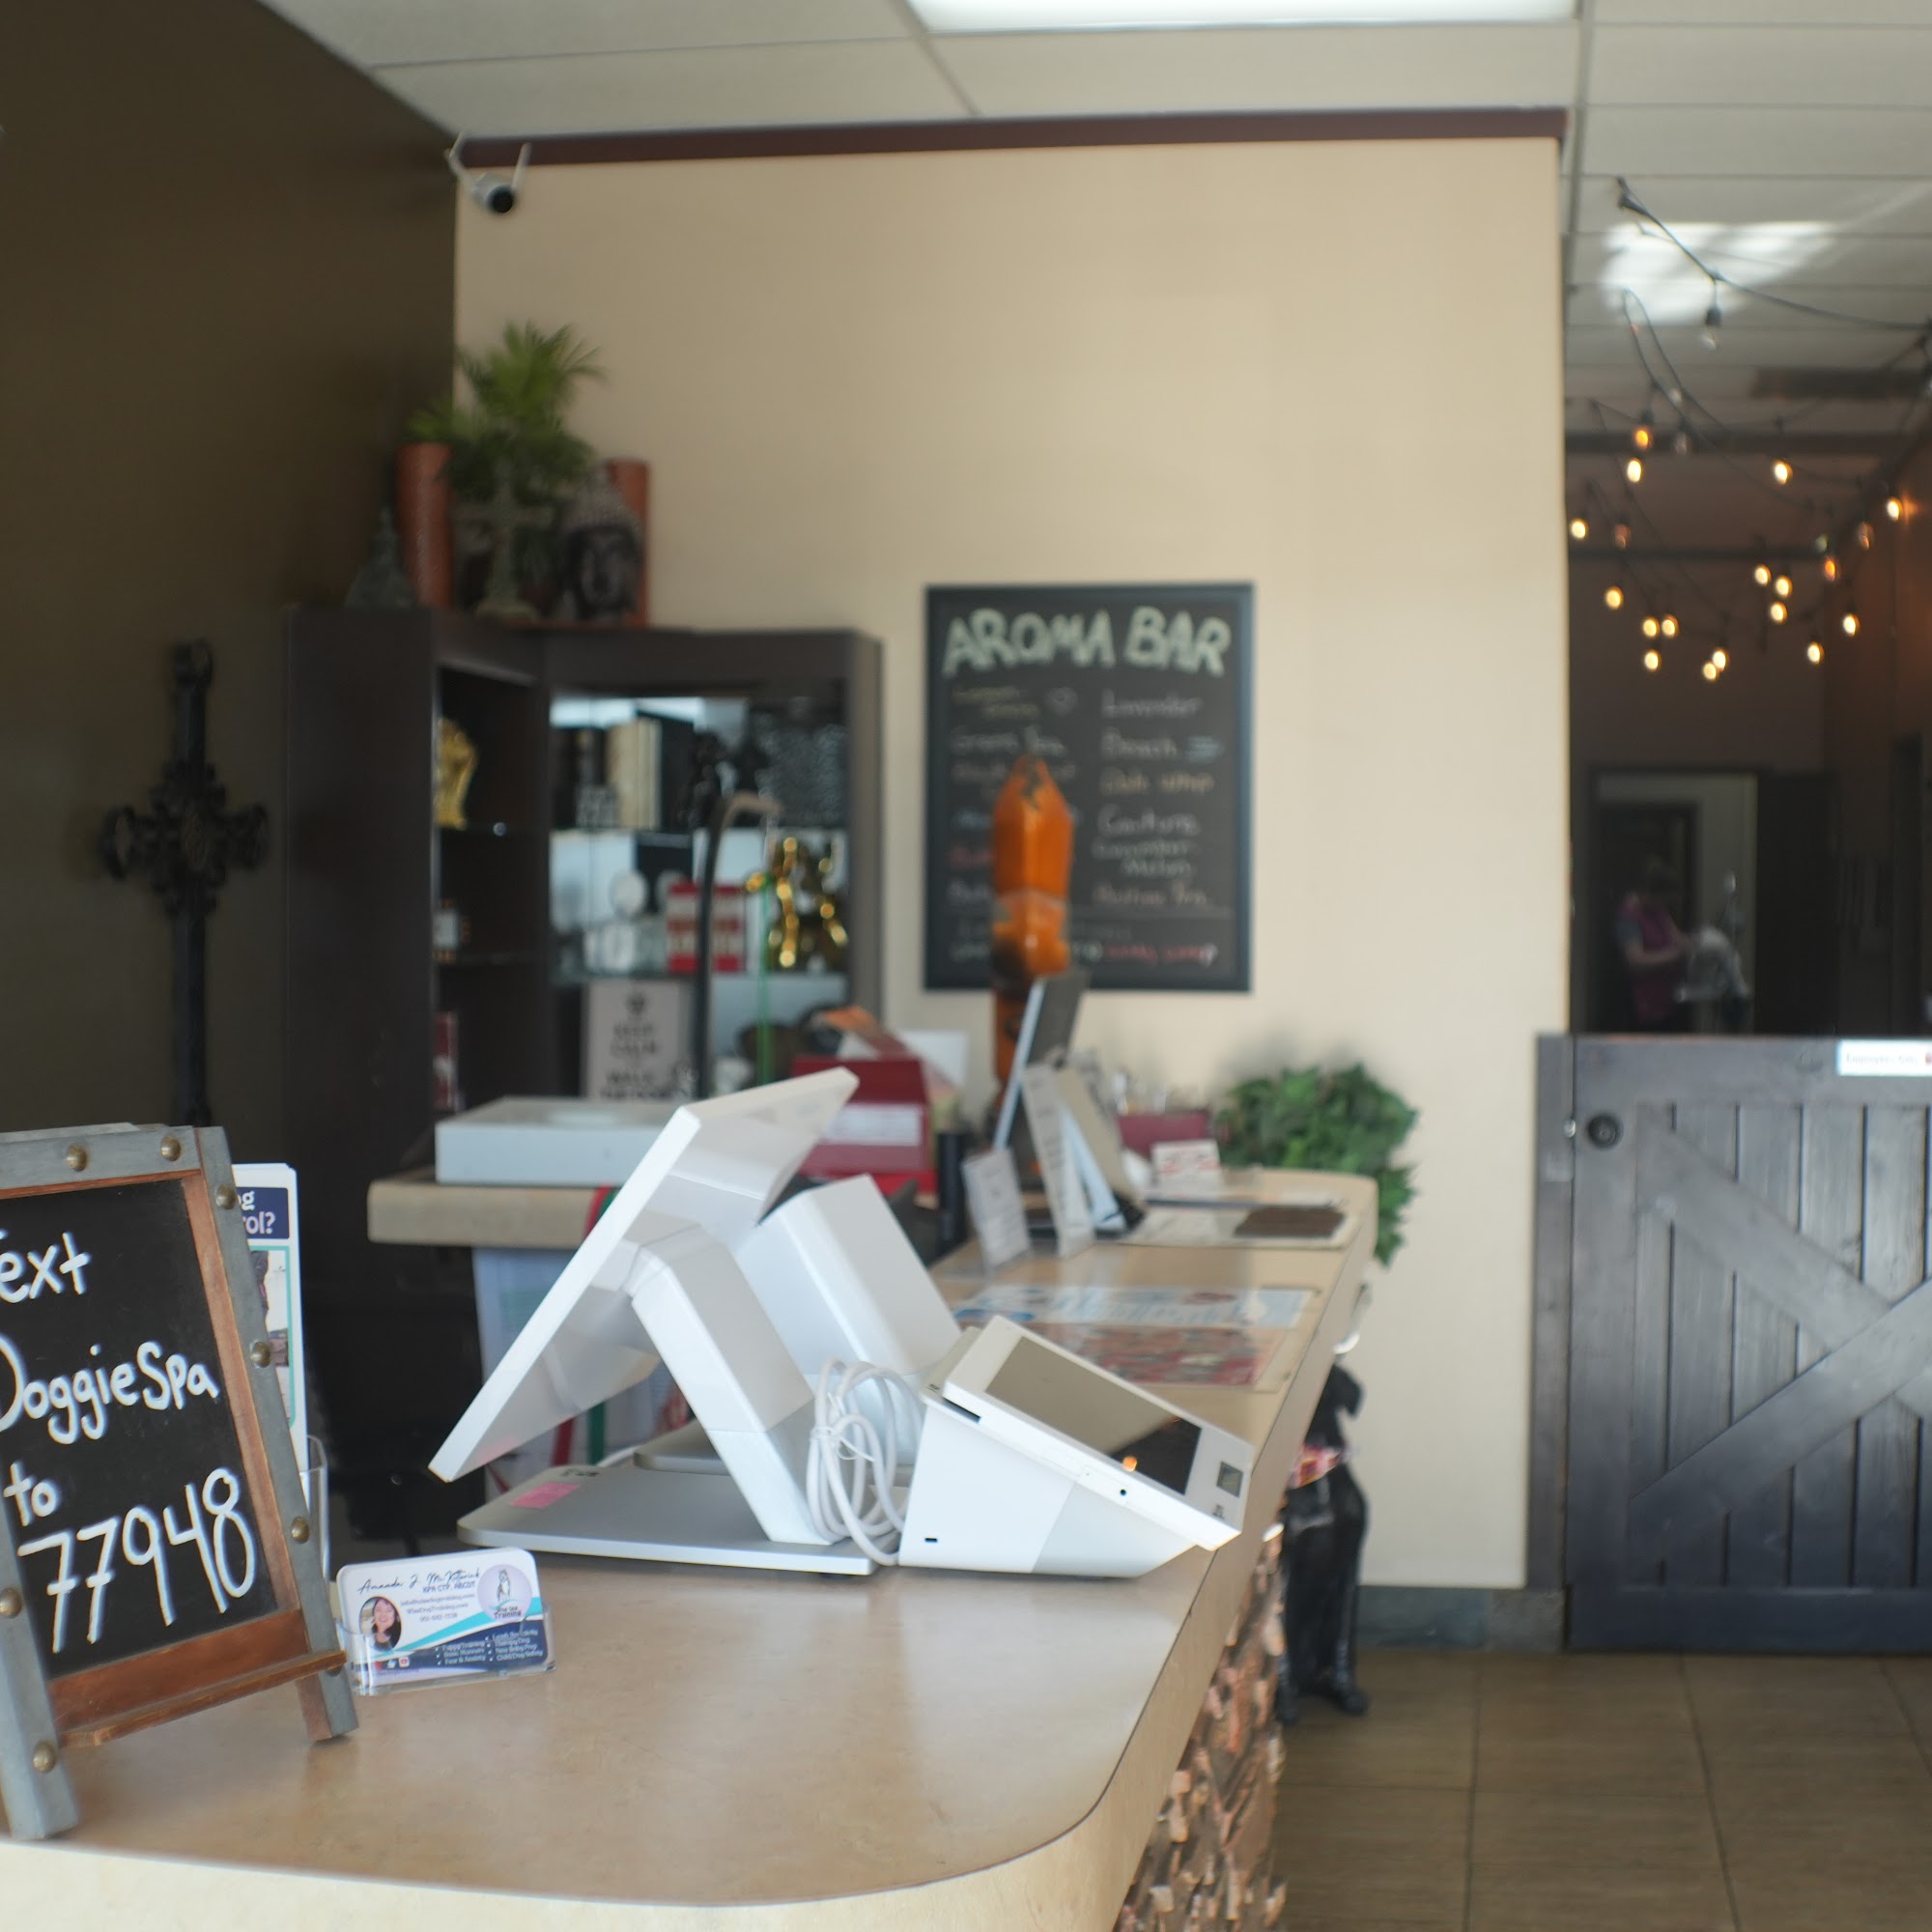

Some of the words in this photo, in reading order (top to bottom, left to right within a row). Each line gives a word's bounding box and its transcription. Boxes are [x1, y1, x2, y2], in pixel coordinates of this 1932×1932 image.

[942, 607, 1117, 677] AROMA
[1122, 604, 1232, 676] BAR
[242, 1210, 276, 1235] ol?
[0, 1229, 90, 1303] ext
[3, 1460, 58, 1526] to
[16, 1466, 256, 1653] 77948
[356, 1577, 404, 1595] Amanda
